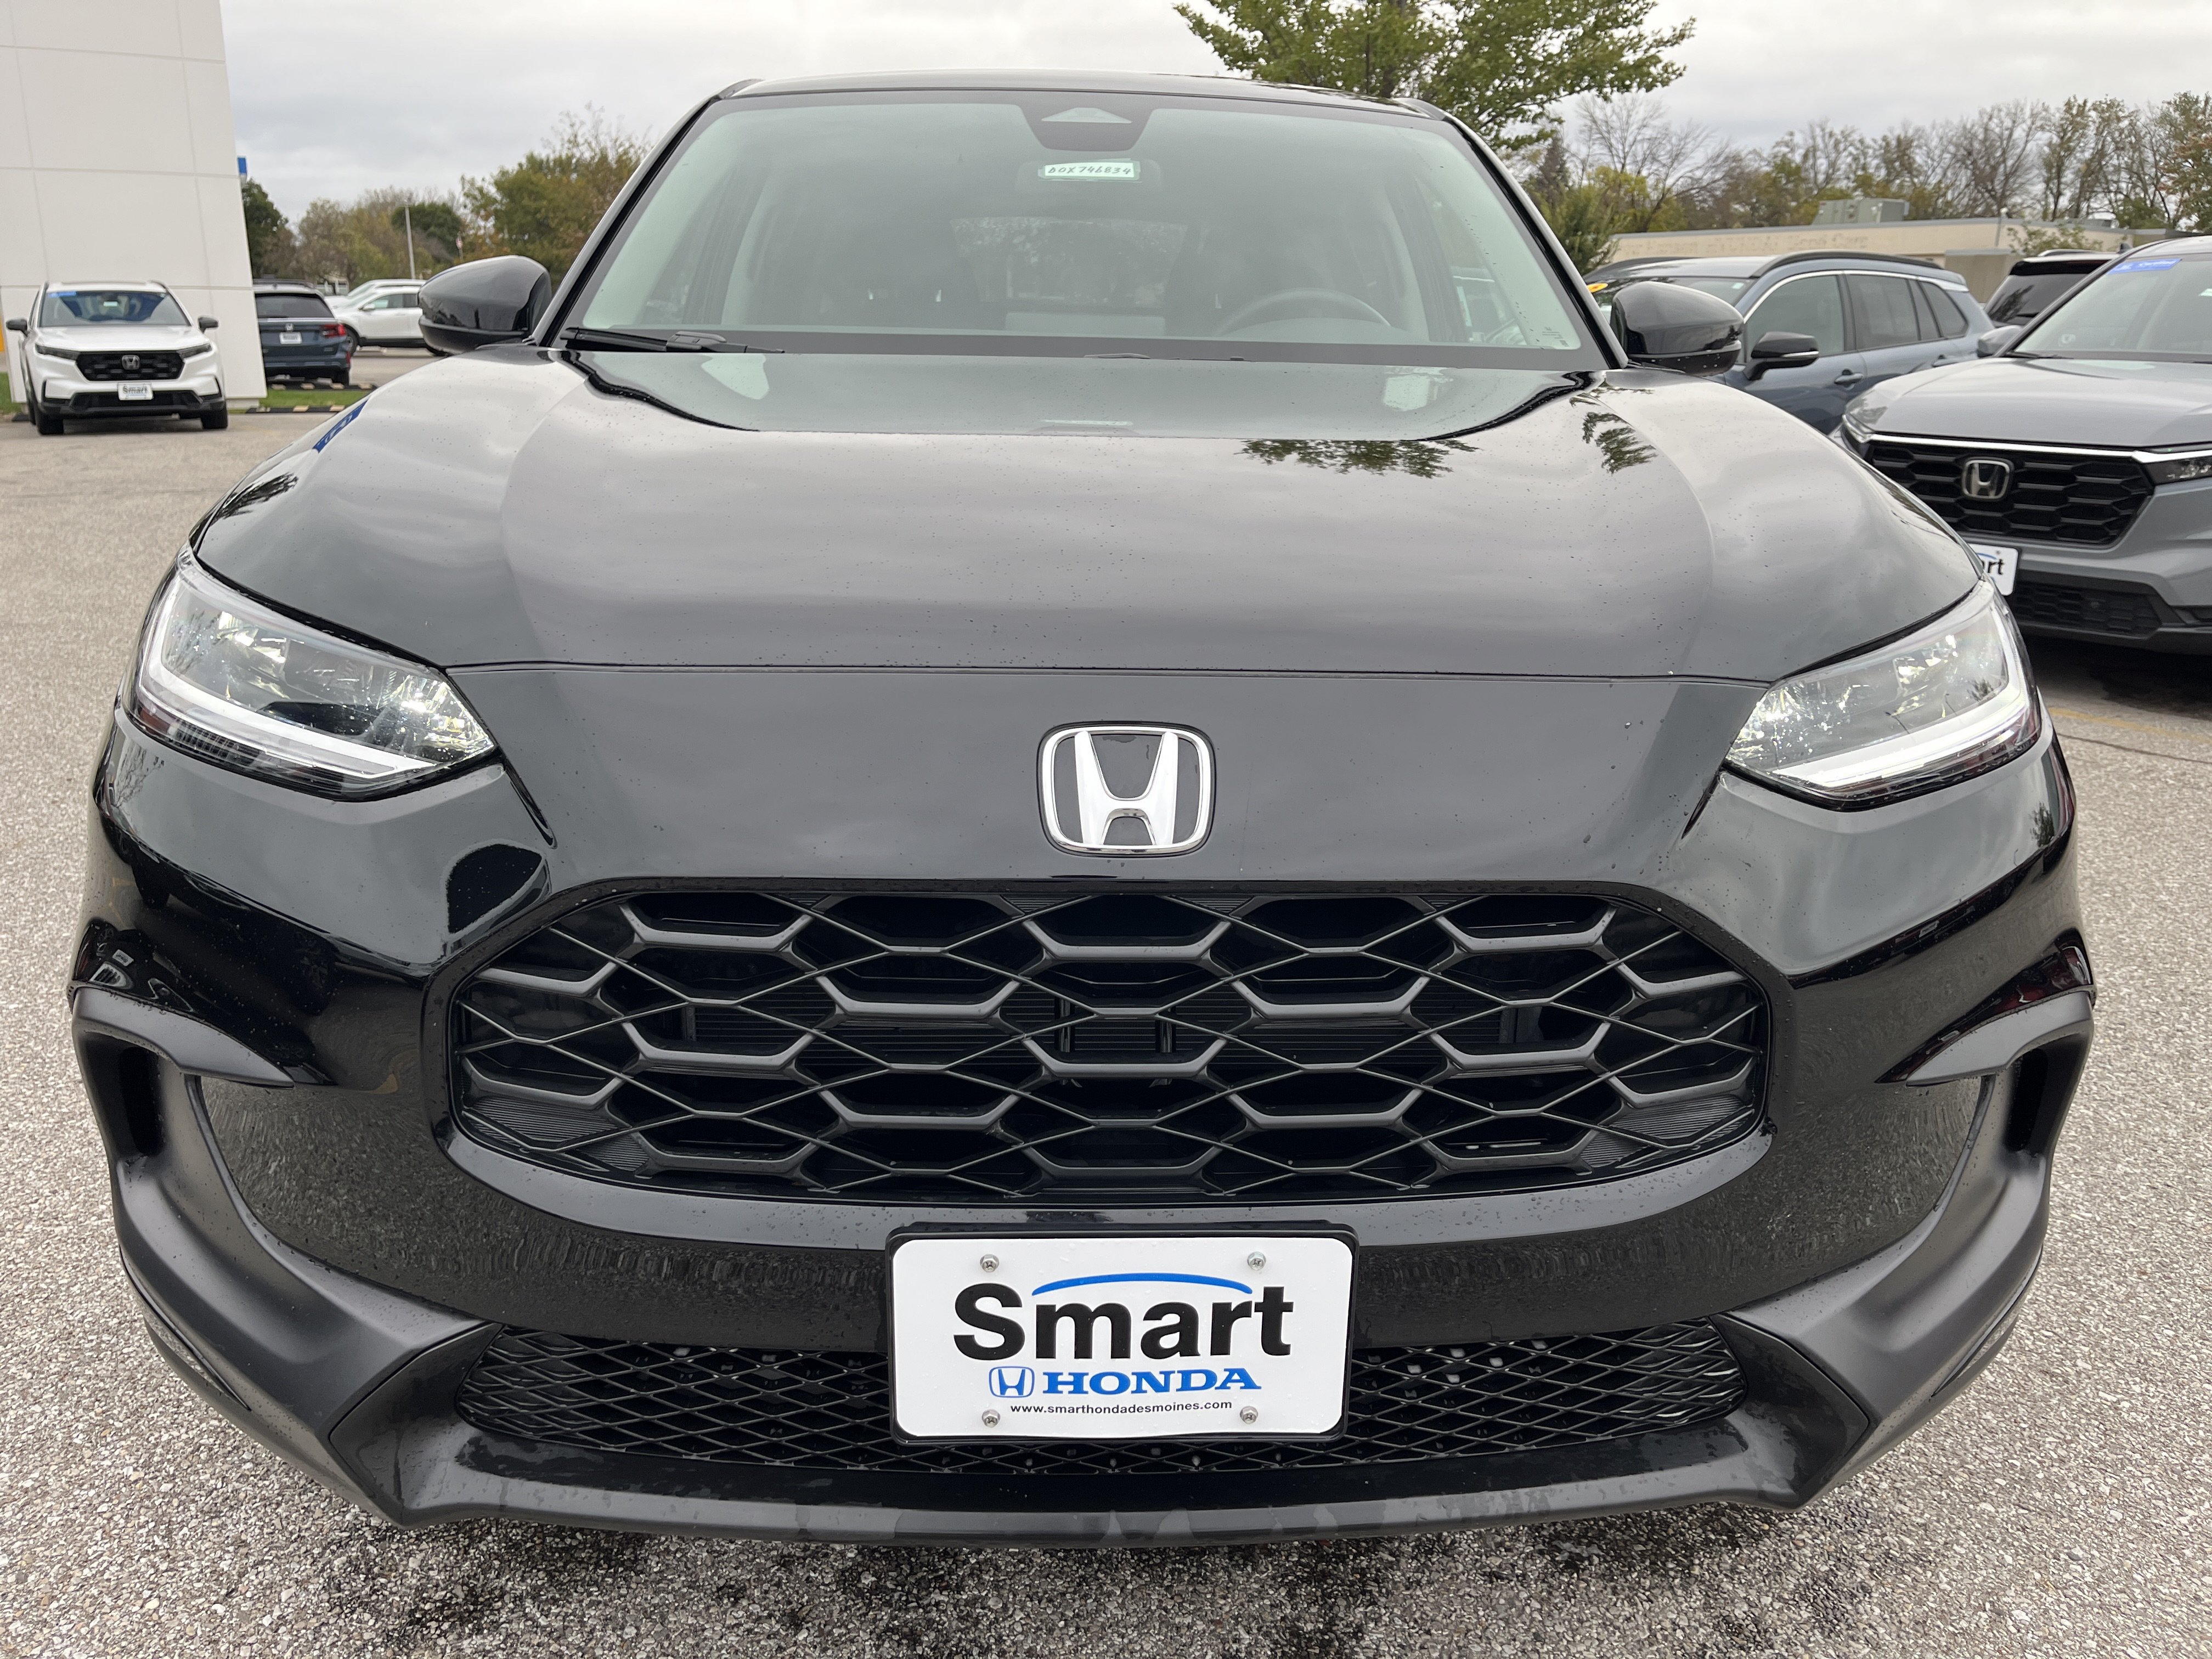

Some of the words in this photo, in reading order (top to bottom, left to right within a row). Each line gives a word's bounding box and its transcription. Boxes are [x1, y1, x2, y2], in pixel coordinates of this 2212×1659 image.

[953, 1283, 1294, 1361] Smart
[1043, 1367, 1262, 1396] HONDA
[1010, 1400, 1232, 1414] www.smarthondadesmoines.com
